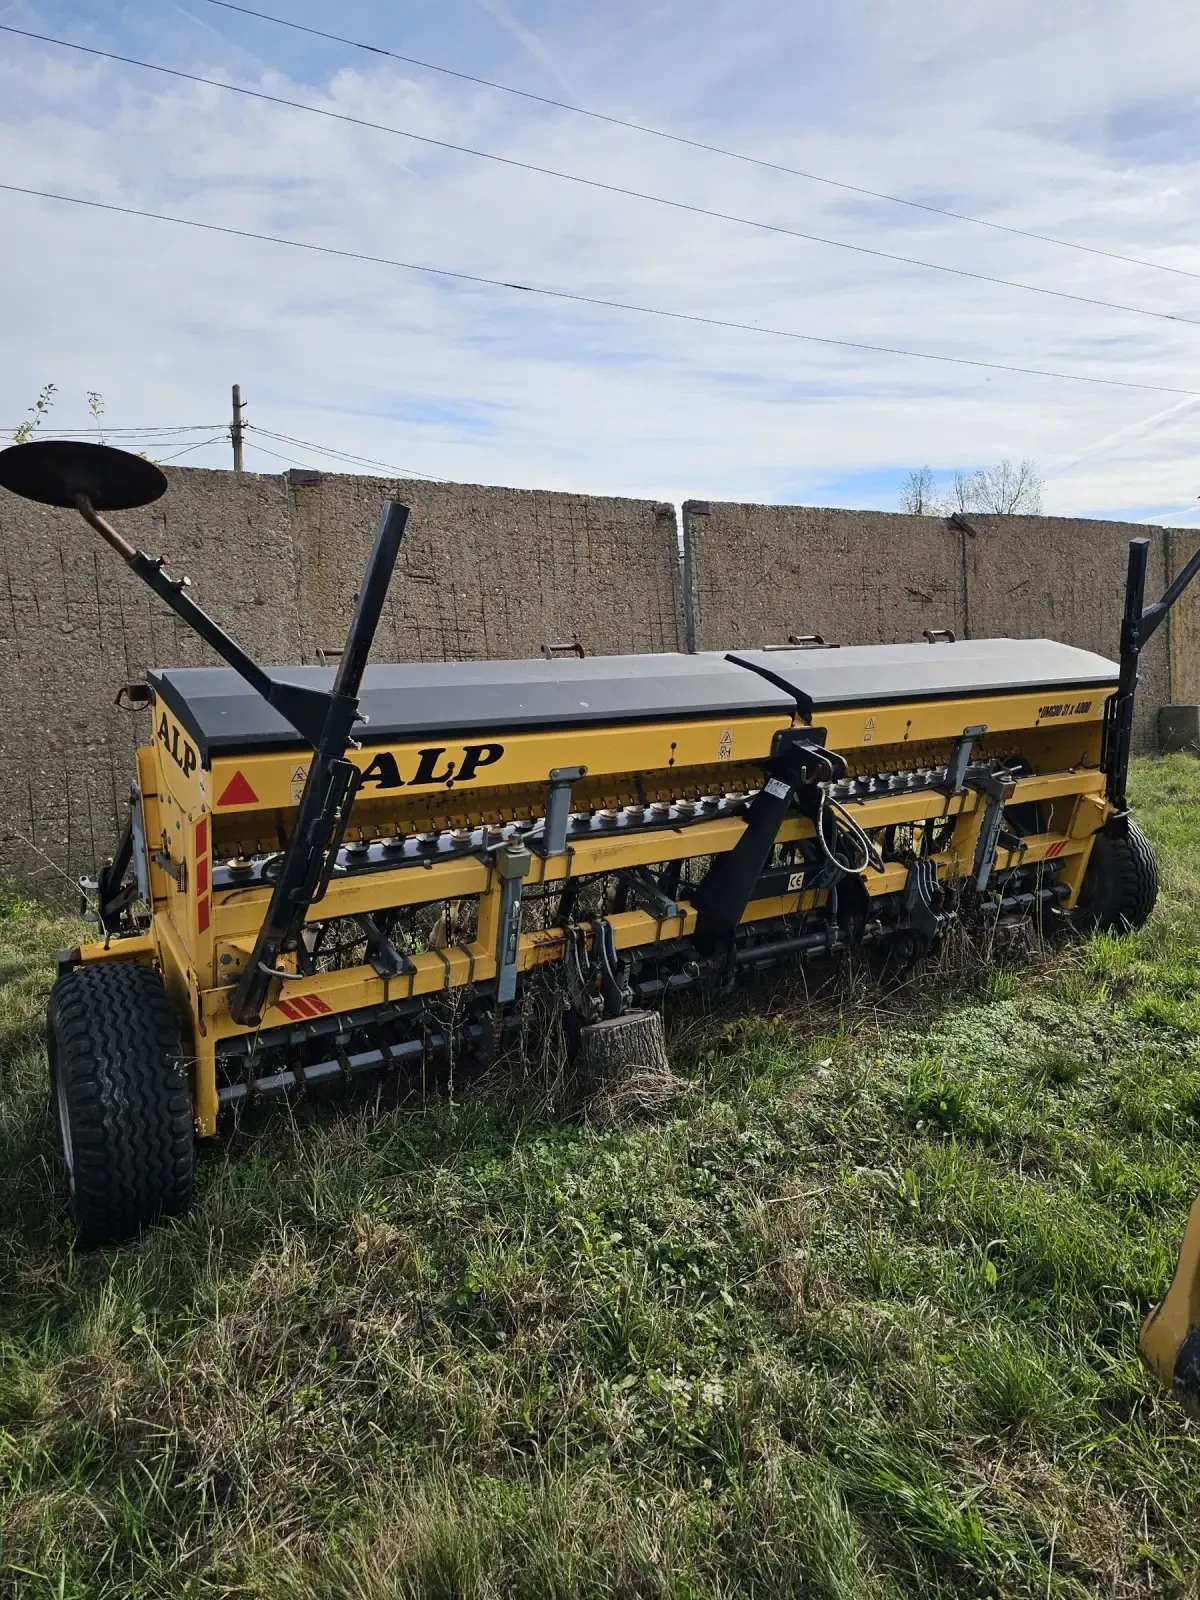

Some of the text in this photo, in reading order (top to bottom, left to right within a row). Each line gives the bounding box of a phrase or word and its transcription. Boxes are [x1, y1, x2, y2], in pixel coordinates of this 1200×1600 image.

[1074, 701, 1092, 714] 4000
[157, 711, 197, 779] ALP
[358, 743, 505, 790] ALP
[790, 874, 803, 888] CE
